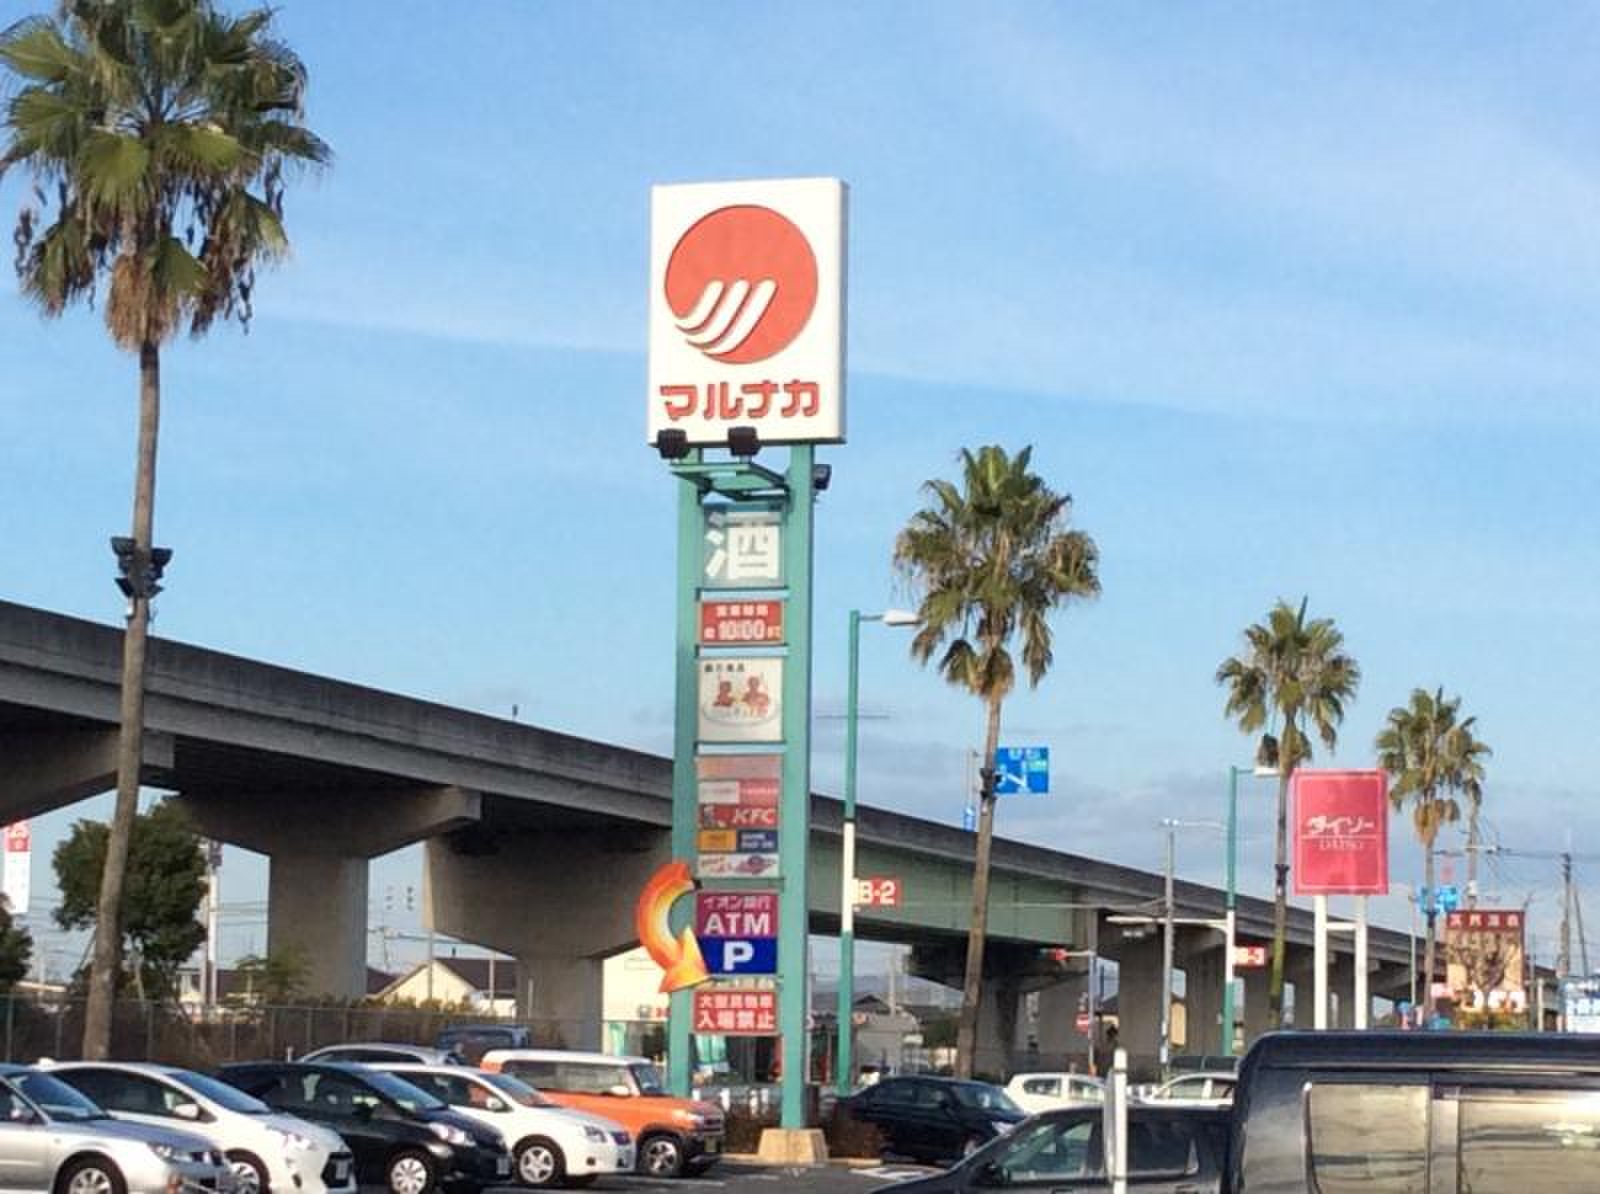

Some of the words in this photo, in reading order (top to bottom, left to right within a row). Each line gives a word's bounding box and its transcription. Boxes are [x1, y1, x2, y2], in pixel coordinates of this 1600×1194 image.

[659, 379, 820, 421] マルナカ
[705, 511, 781, 580] 酒
[732, 808, 776, 825] KFC
[703, 911, 771, 936] ATM
[723, 940, 755, 971] P
[697, 1009, 776, 1030] 入場禁止
